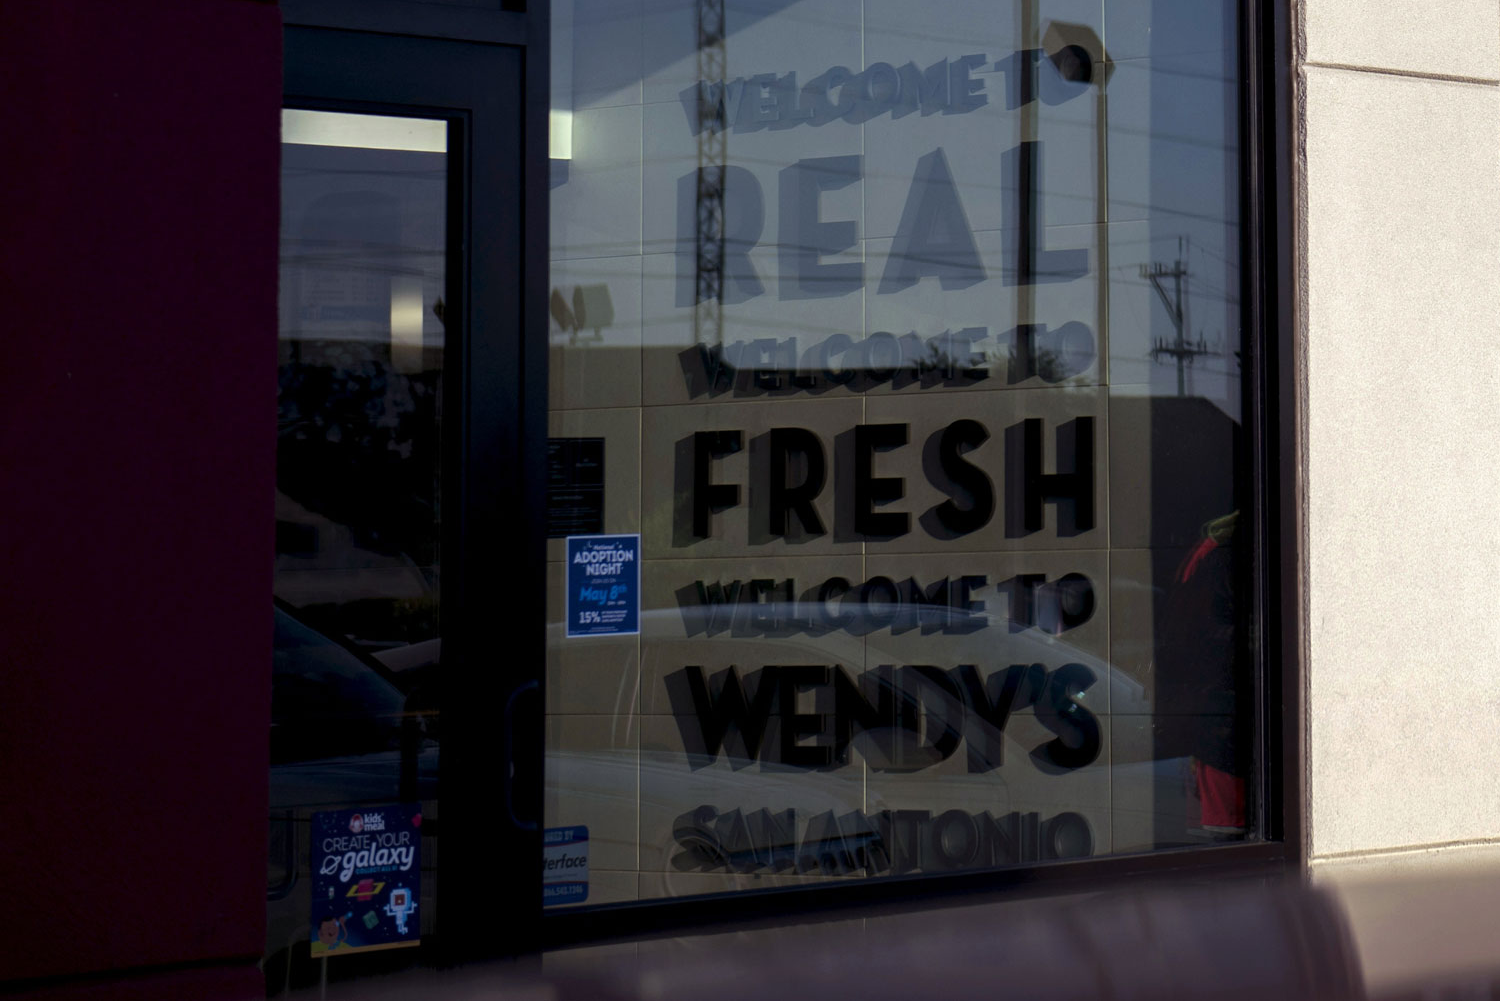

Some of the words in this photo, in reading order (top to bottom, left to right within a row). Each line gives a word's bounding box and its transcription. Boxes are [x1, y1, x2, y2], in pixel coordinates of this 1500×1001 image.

[679, 54, 989, 136] WELCOME
[674, 141, 1089, 308] REAL
[680, 327, 989, 398] WELCOME
[998, 321, 1096, 385] TO
[674, 416, 1095, 545] FRESH
[573, 549, 634, 564] ADOPTION
[586, 562, 623, 576] NIGHT
[579, 586, 609, 605] May
[579, 611, 601, 624] 15%
[676, 575, 989, 637] WELCOME
[998, 573, 1096, 634] TO
[665, 663, 1102, 774] WENDY'S
[322, 834, 371, 853] CREATE
[375, 831, 411, 847] YOUR
[364, 820, 386, 831] meal
[676, 805, 796, 872] SAN
[800, 809, 1095, 875] ANTONIO
[340, 842, 415, 883] galaxy
